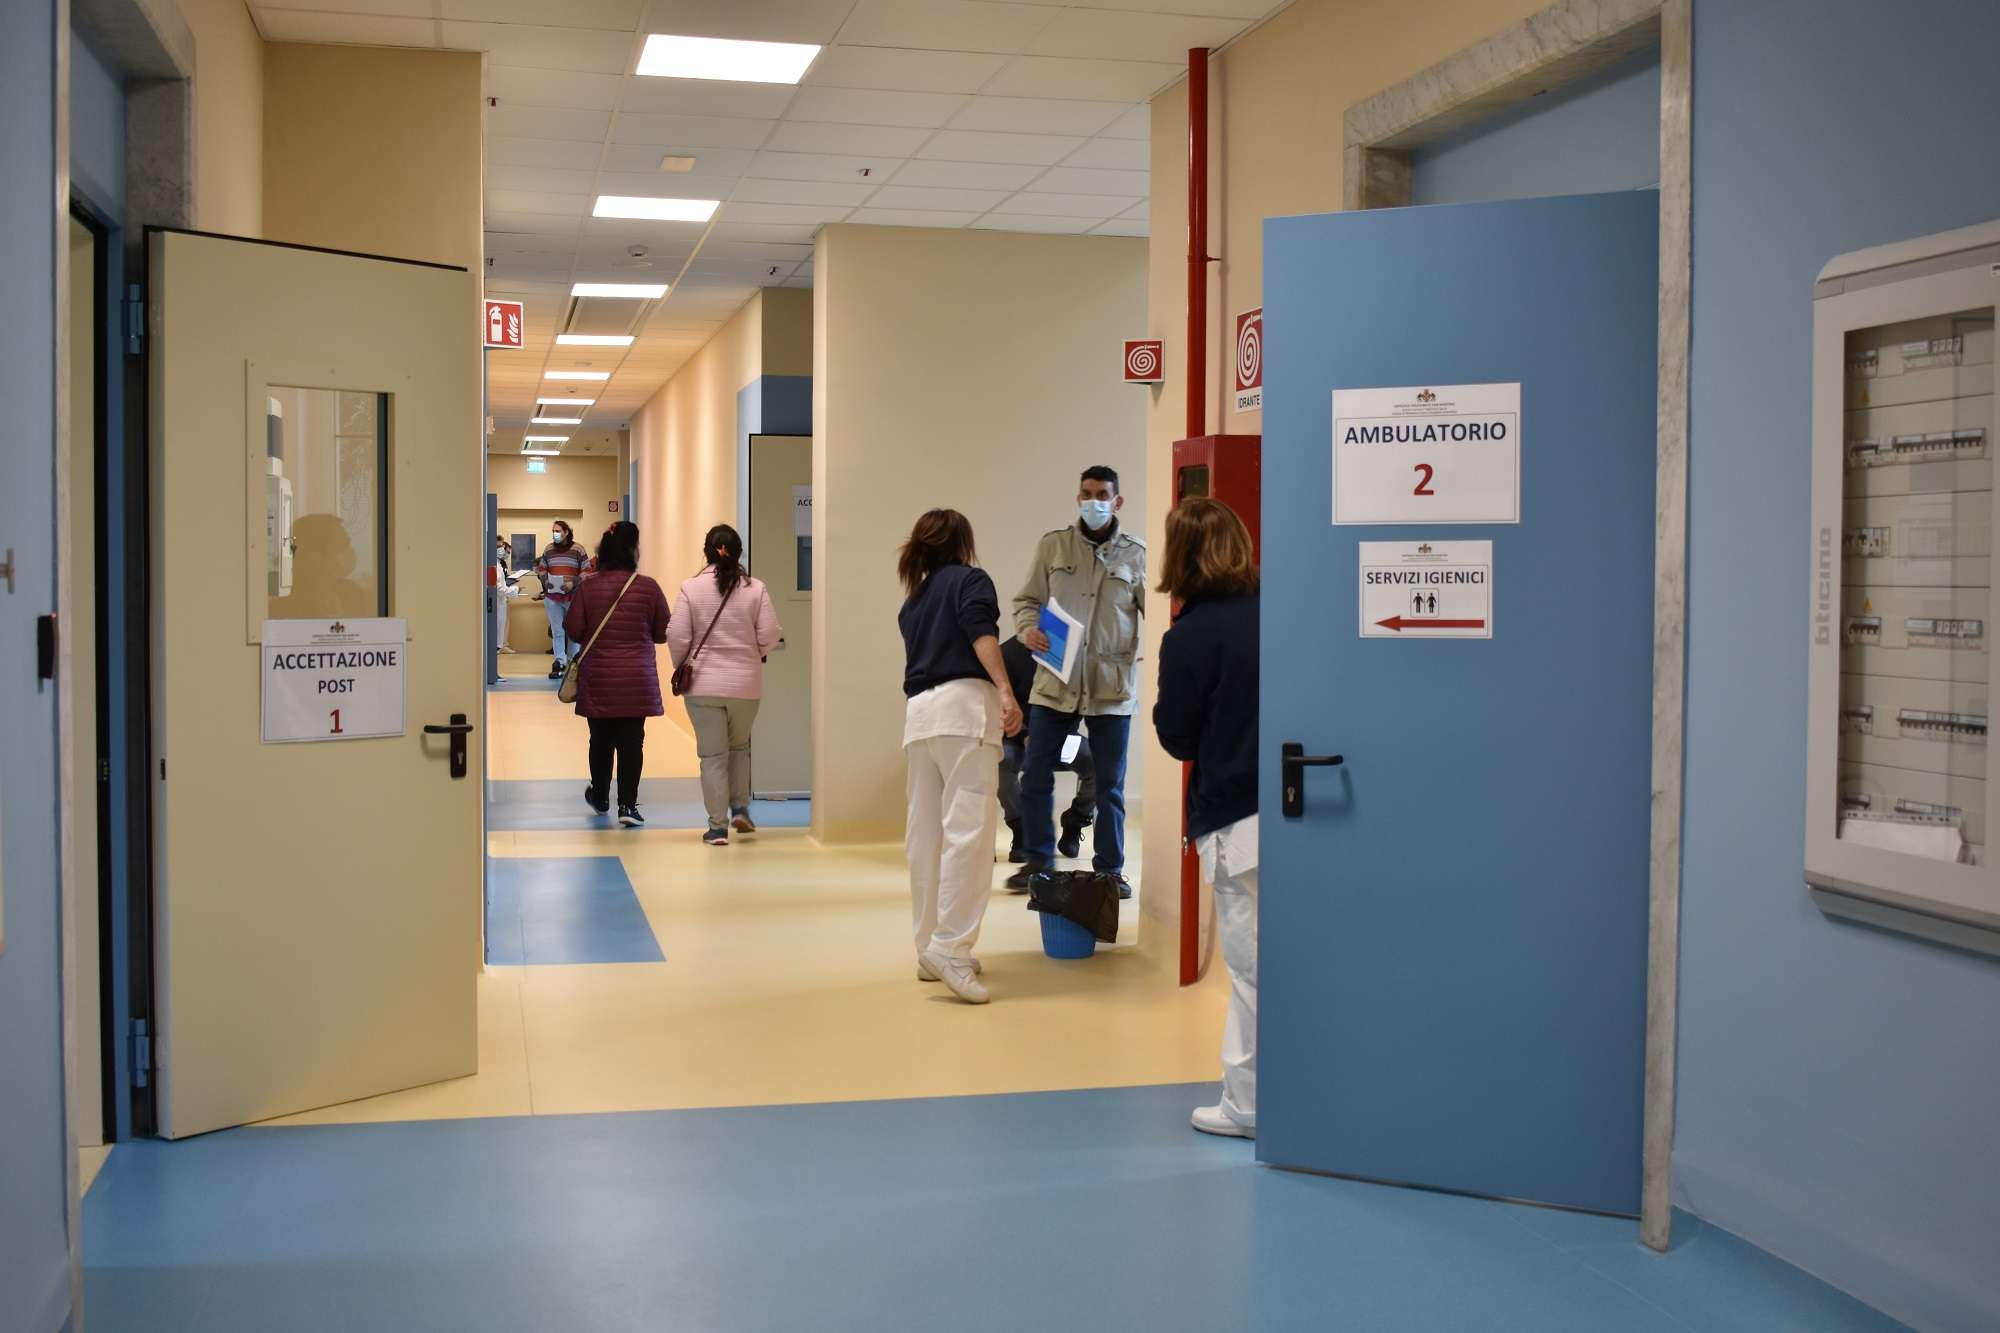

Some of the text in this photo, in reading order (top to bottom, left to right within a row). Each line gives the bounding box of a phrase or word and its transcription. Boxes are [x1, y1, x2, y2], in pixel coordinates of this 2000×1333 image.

[1238, 394, 1260, 409] IDRANTE
[1344, 422, 1507, 445] AMBULATORIO
[1413, 463, 1434, 496] 2
[1366, 571, 1485, 585] SERVIZI IGIENICI
[1814, 527, 1831, 645] bticino
[273, 650, 397, 671] ACCETTAZIONE
[318, 678, 355, 695] POST
[330, 708, 343, 734] 1
